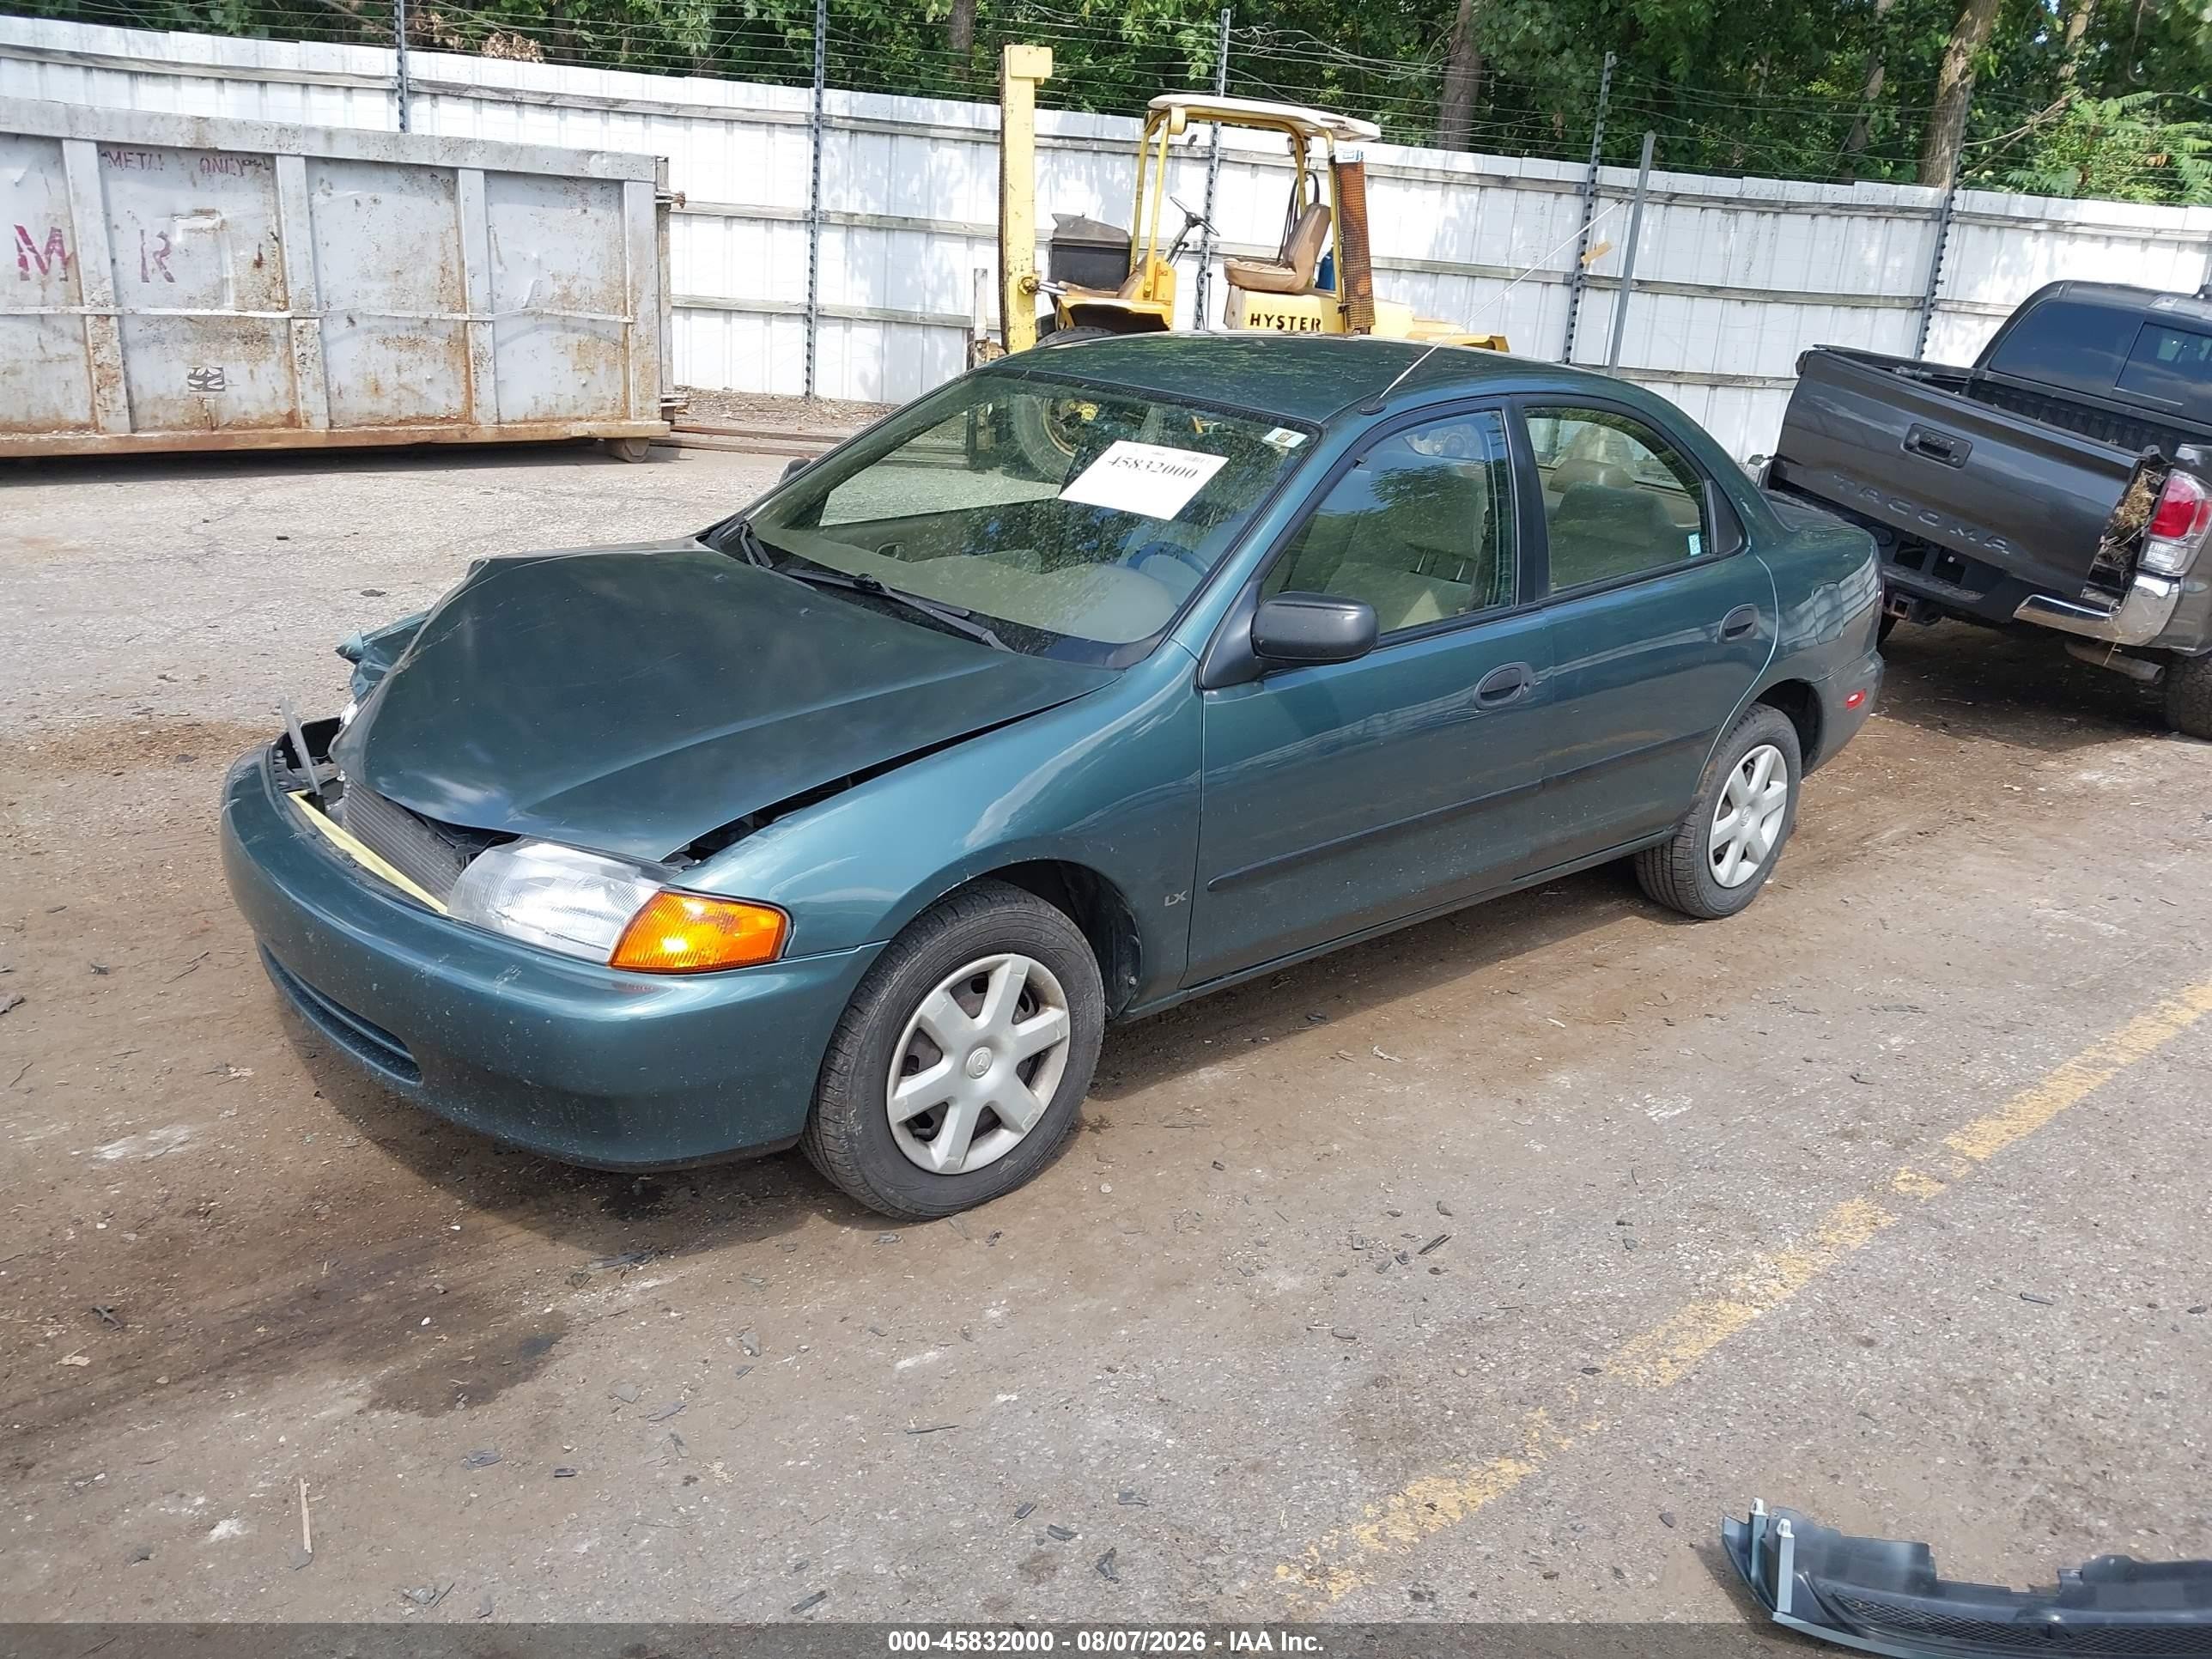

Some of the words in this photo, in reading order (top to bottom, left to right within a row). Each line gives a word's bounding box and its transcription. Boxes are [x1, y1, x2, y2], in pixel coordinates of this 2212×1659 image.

[1249, 313, 1322, 331] HYSTER
[1108, 456, 1199, 479] 45832000
[1833, 473, 2011, 555] TACOMA
[1164, 890, 1188, 907] LX
